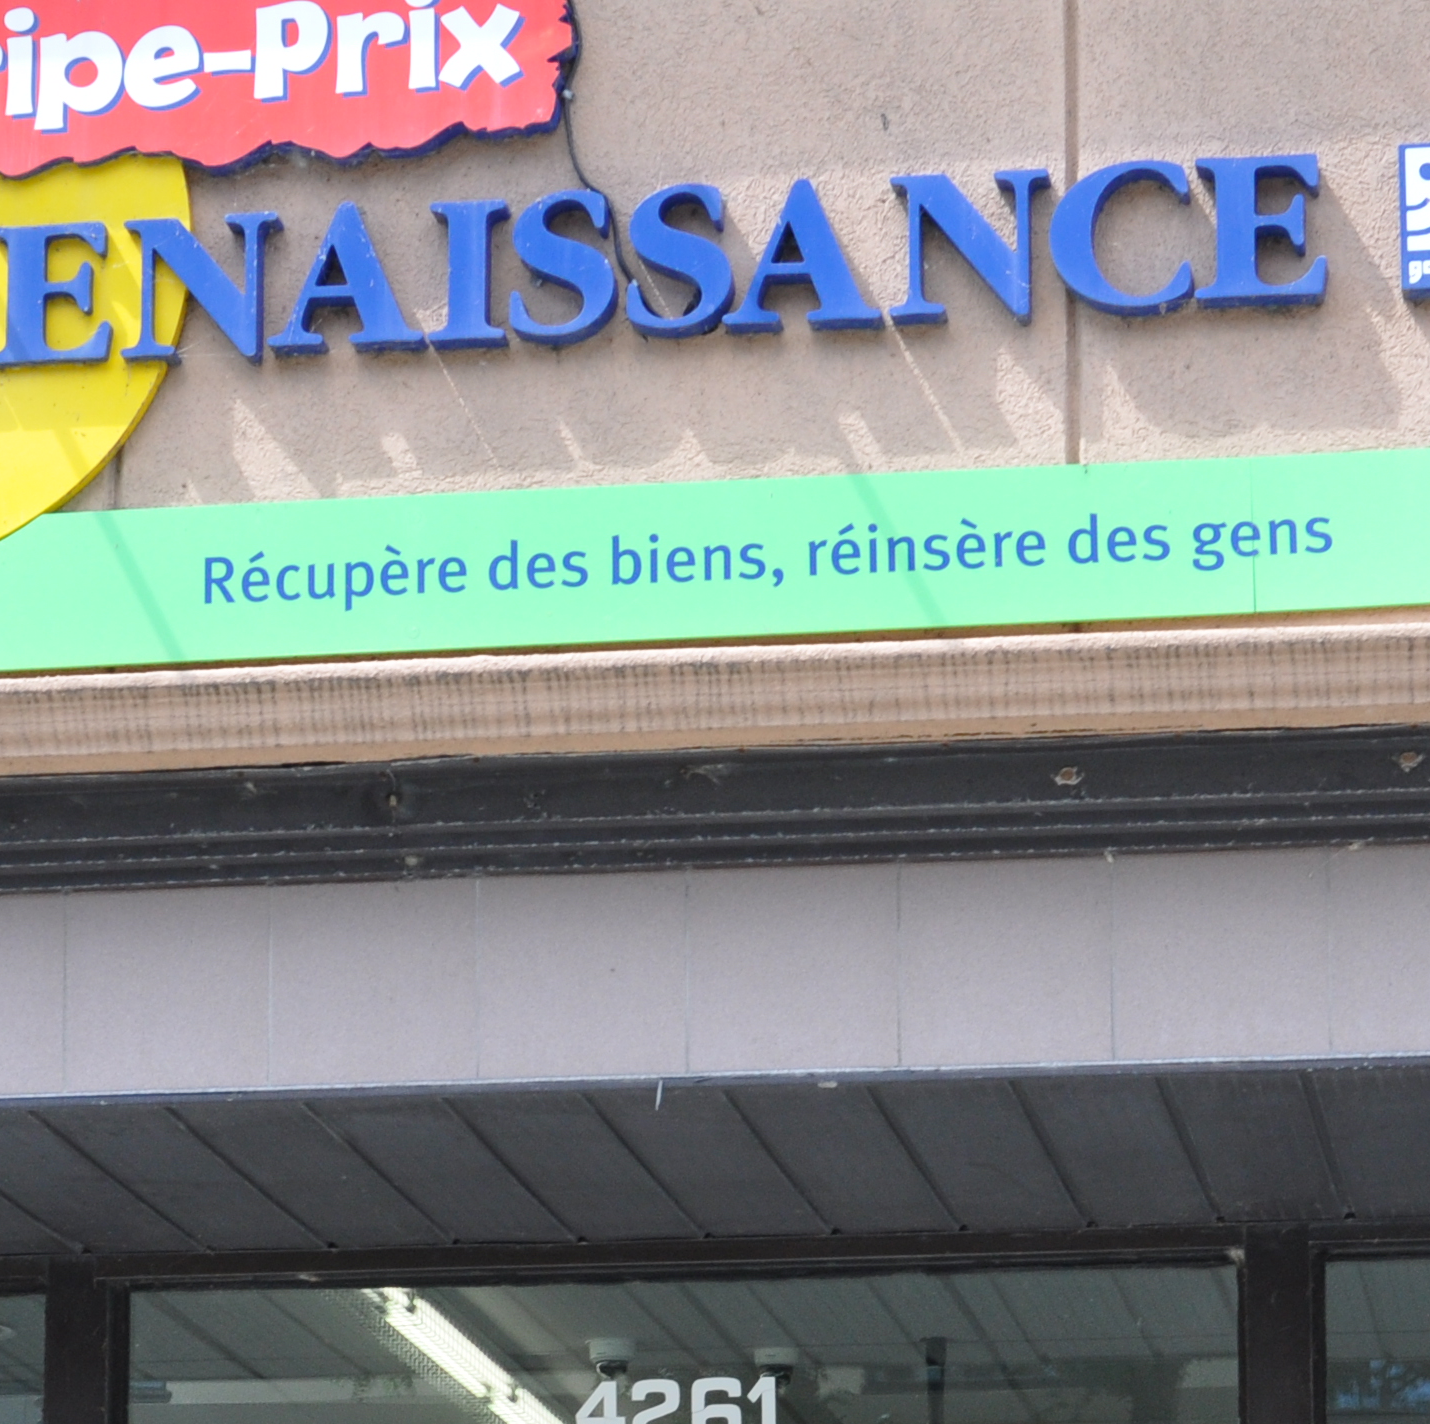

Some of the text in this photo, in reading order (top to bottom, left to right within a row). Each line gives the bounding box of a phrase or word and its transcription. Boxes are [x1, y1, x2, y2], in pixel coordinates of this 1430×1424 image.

[204, 512, 1334, 611] Récupère des biens, réinsère des gens
